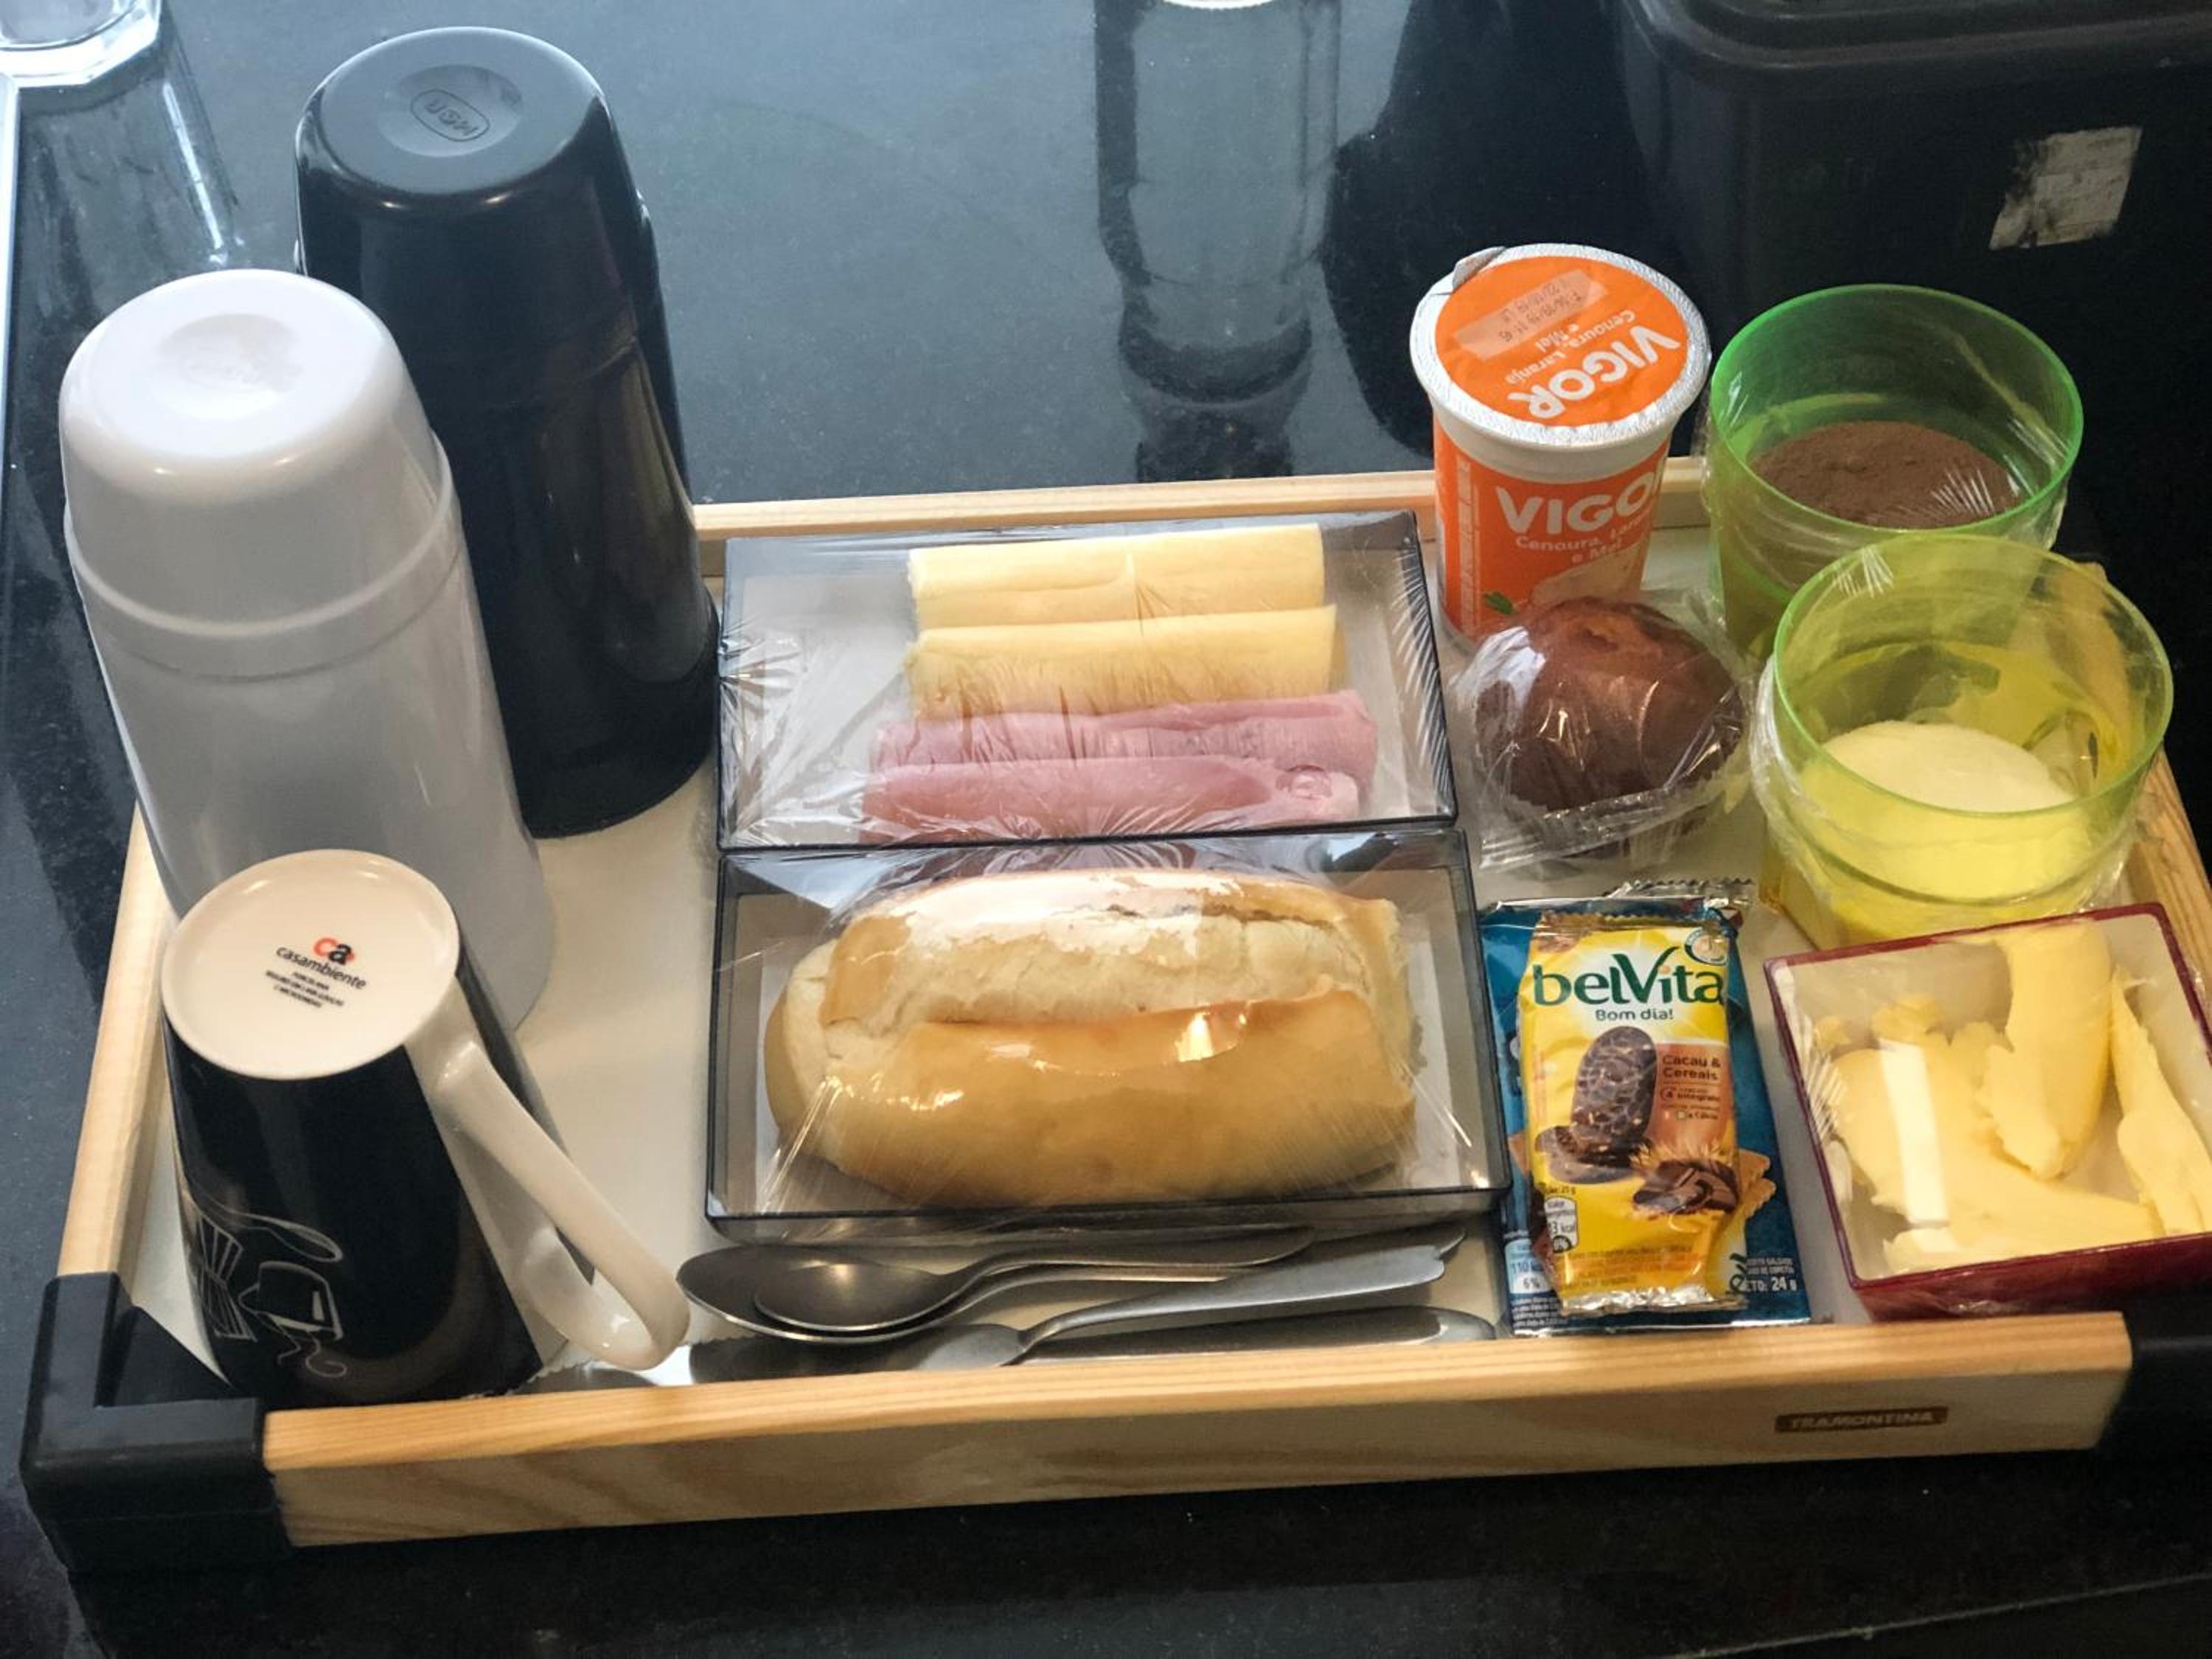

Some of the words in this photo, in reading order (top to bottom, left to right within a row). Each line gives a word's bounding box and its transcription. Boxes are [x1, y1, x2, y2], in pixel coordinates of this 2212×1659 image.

[1507, 350, 1567, 384] Laranja
[1508, 325, 1680, 418] VIGOR
[276, 947, 367, 990] casambiente
[1532, 945, 1725, 1006] belVita
[1596, 1009, 1637, 1022] Bom
[1640, 1008, 1674, 1021] dia!
[1662, 1054, 1708, 1068] Cacau
[1662, 1067, 1719, 1080] Cereais
[1770, 1276, 1787, 1292] 24
[1792, 1411, 1934, 1429] TRAMONTINA
